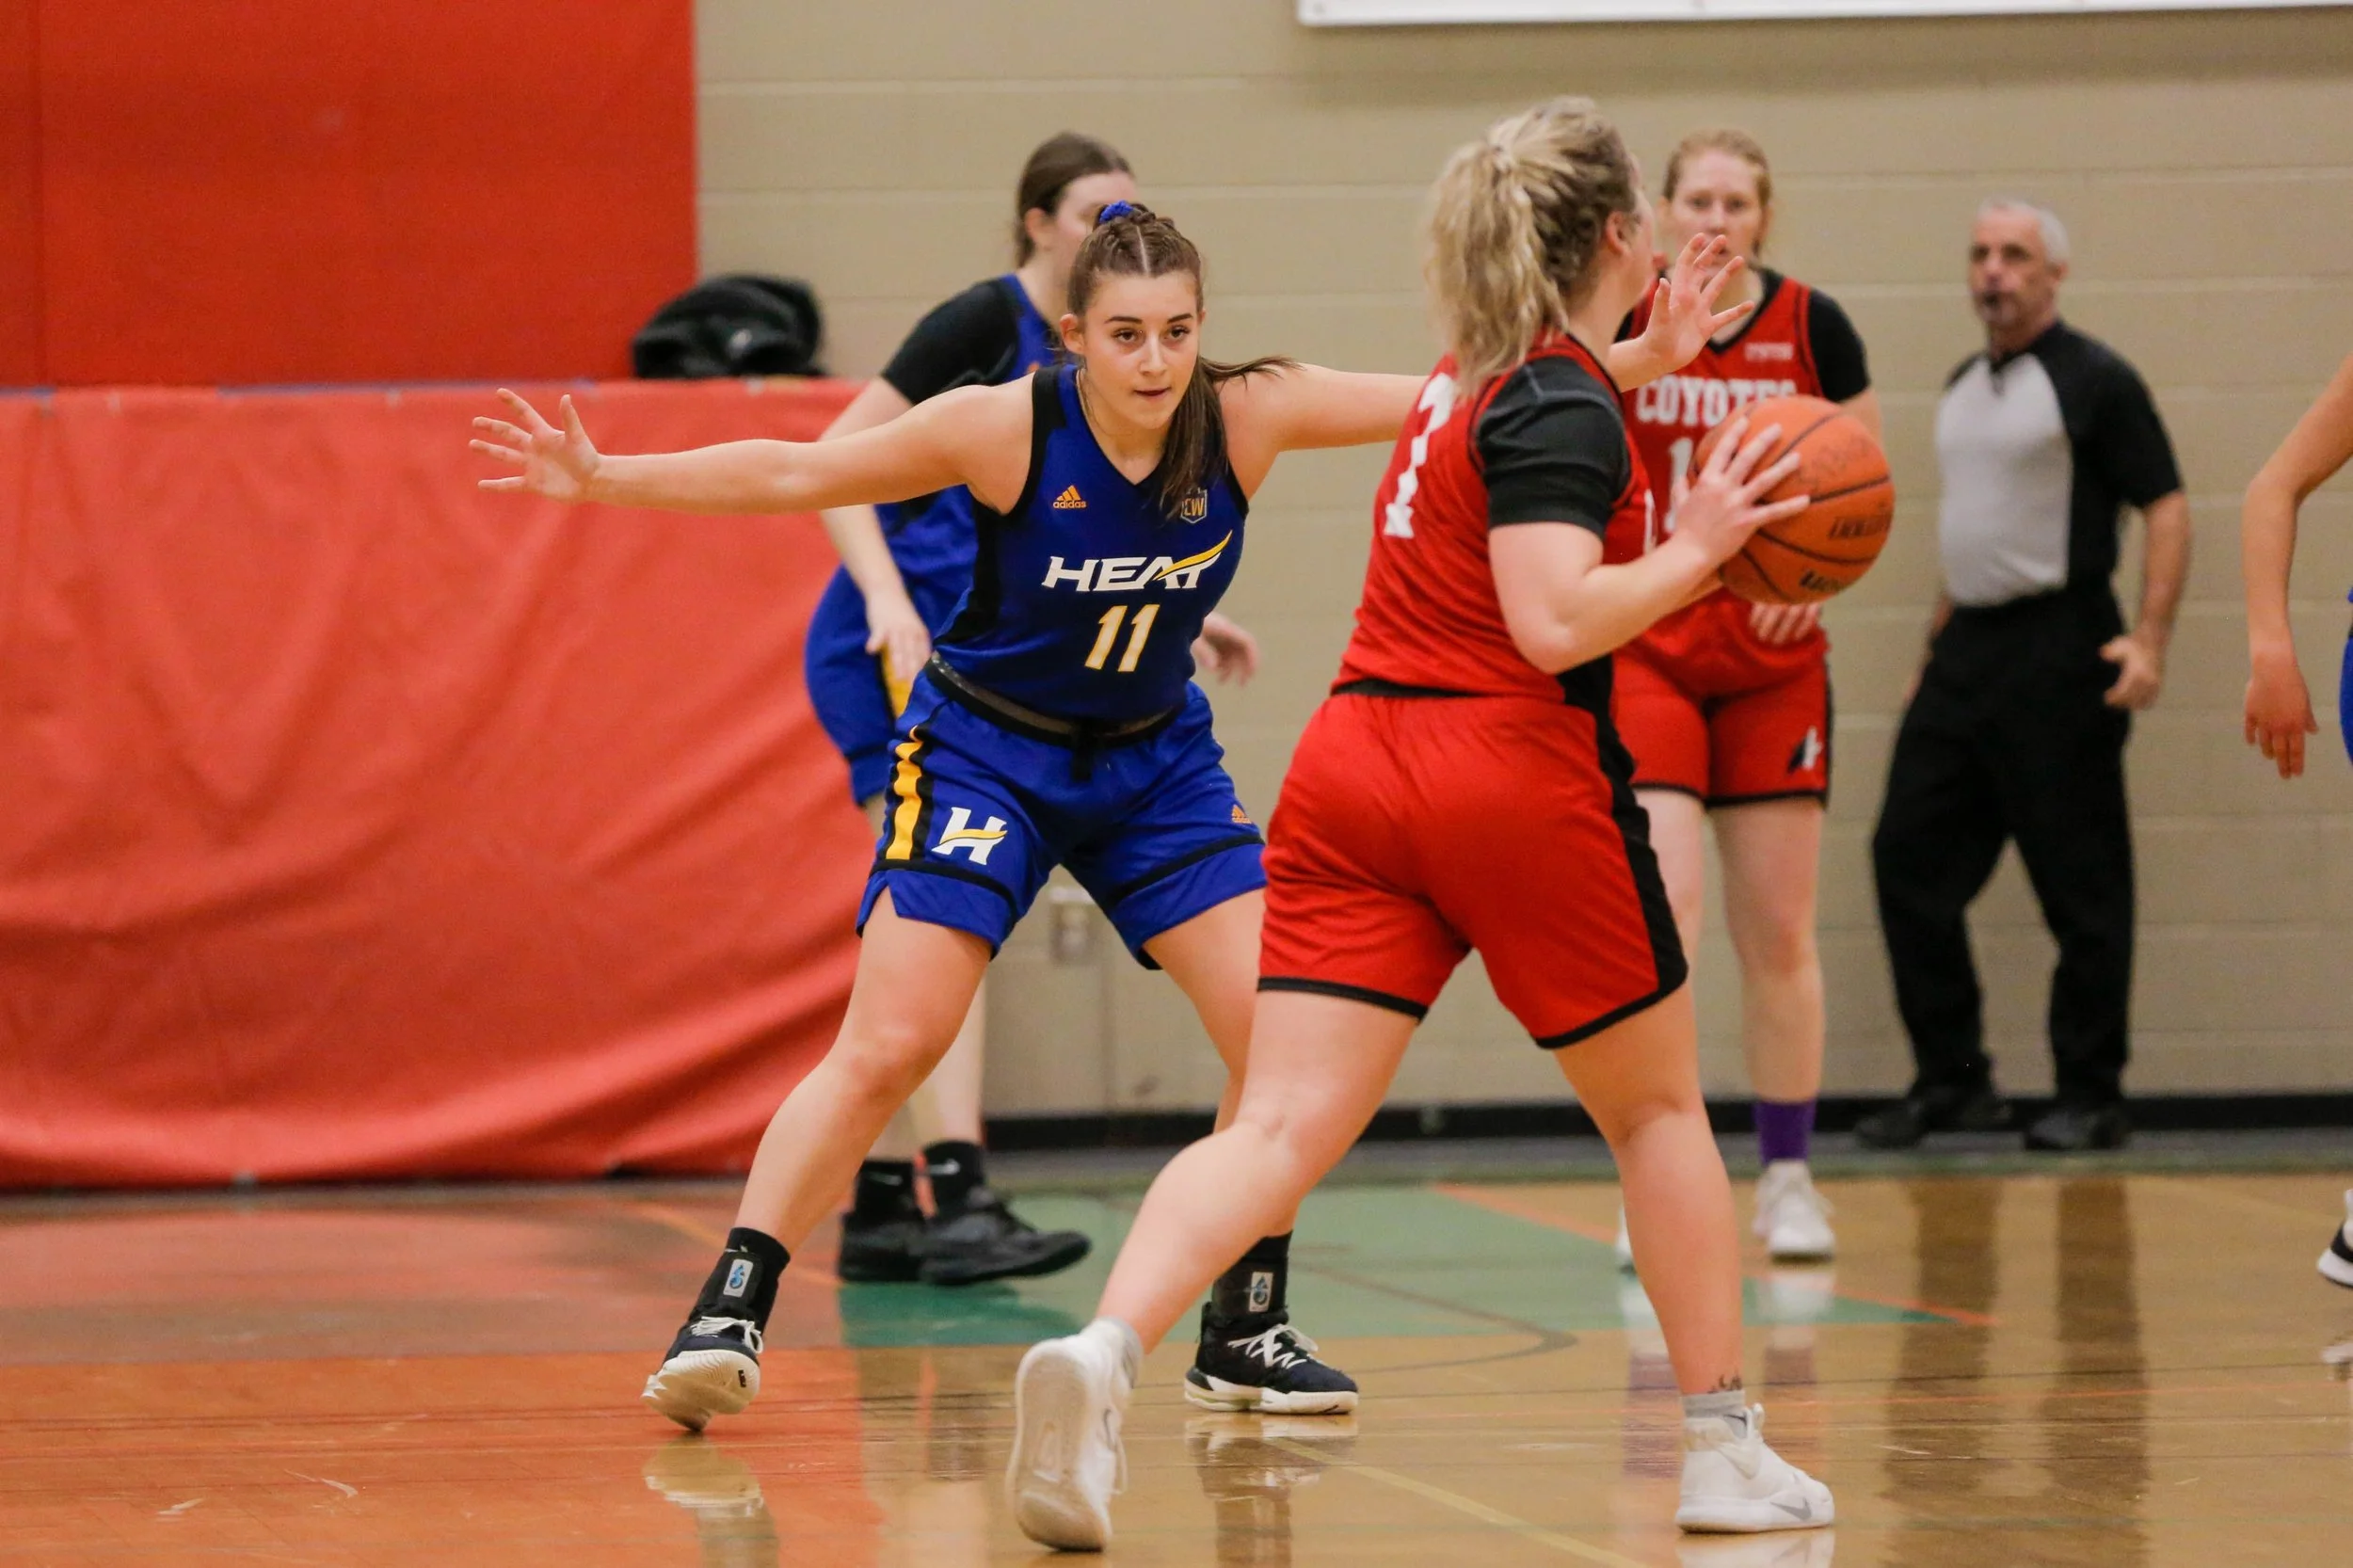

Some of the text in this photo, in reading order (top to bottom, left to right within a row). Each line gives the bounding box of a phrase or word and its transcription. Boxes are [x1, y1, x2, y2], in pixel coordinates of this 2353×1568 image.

[1052, 500, 1086, 508] adidas
[1041, 546, 1225, 592] HEAT
[1084, 603, 1160, 672] 11
[931, 806, 1008, 865] H
